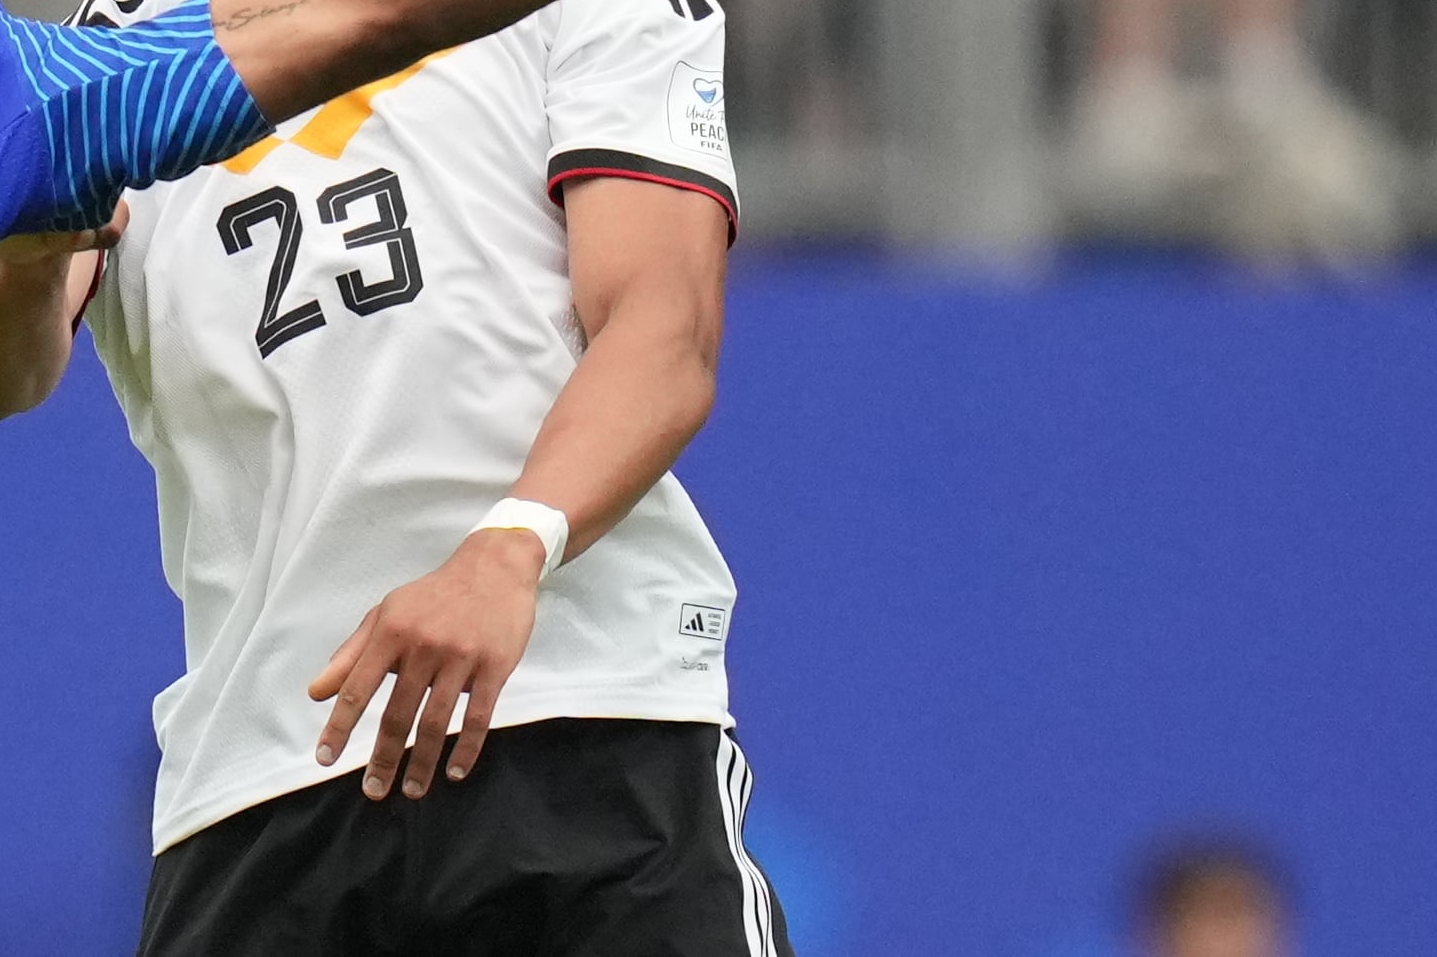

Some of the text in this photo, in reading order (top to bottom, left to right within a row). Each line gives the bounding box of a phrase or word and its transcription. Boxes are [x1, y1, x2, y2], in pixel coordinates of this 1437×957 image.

[685, 104, 716, 121] Unite
[691, 122, 725, 142] PEAC
[700, 140, 723, 151] FIFA
[216, 167, 424, 360] 23
